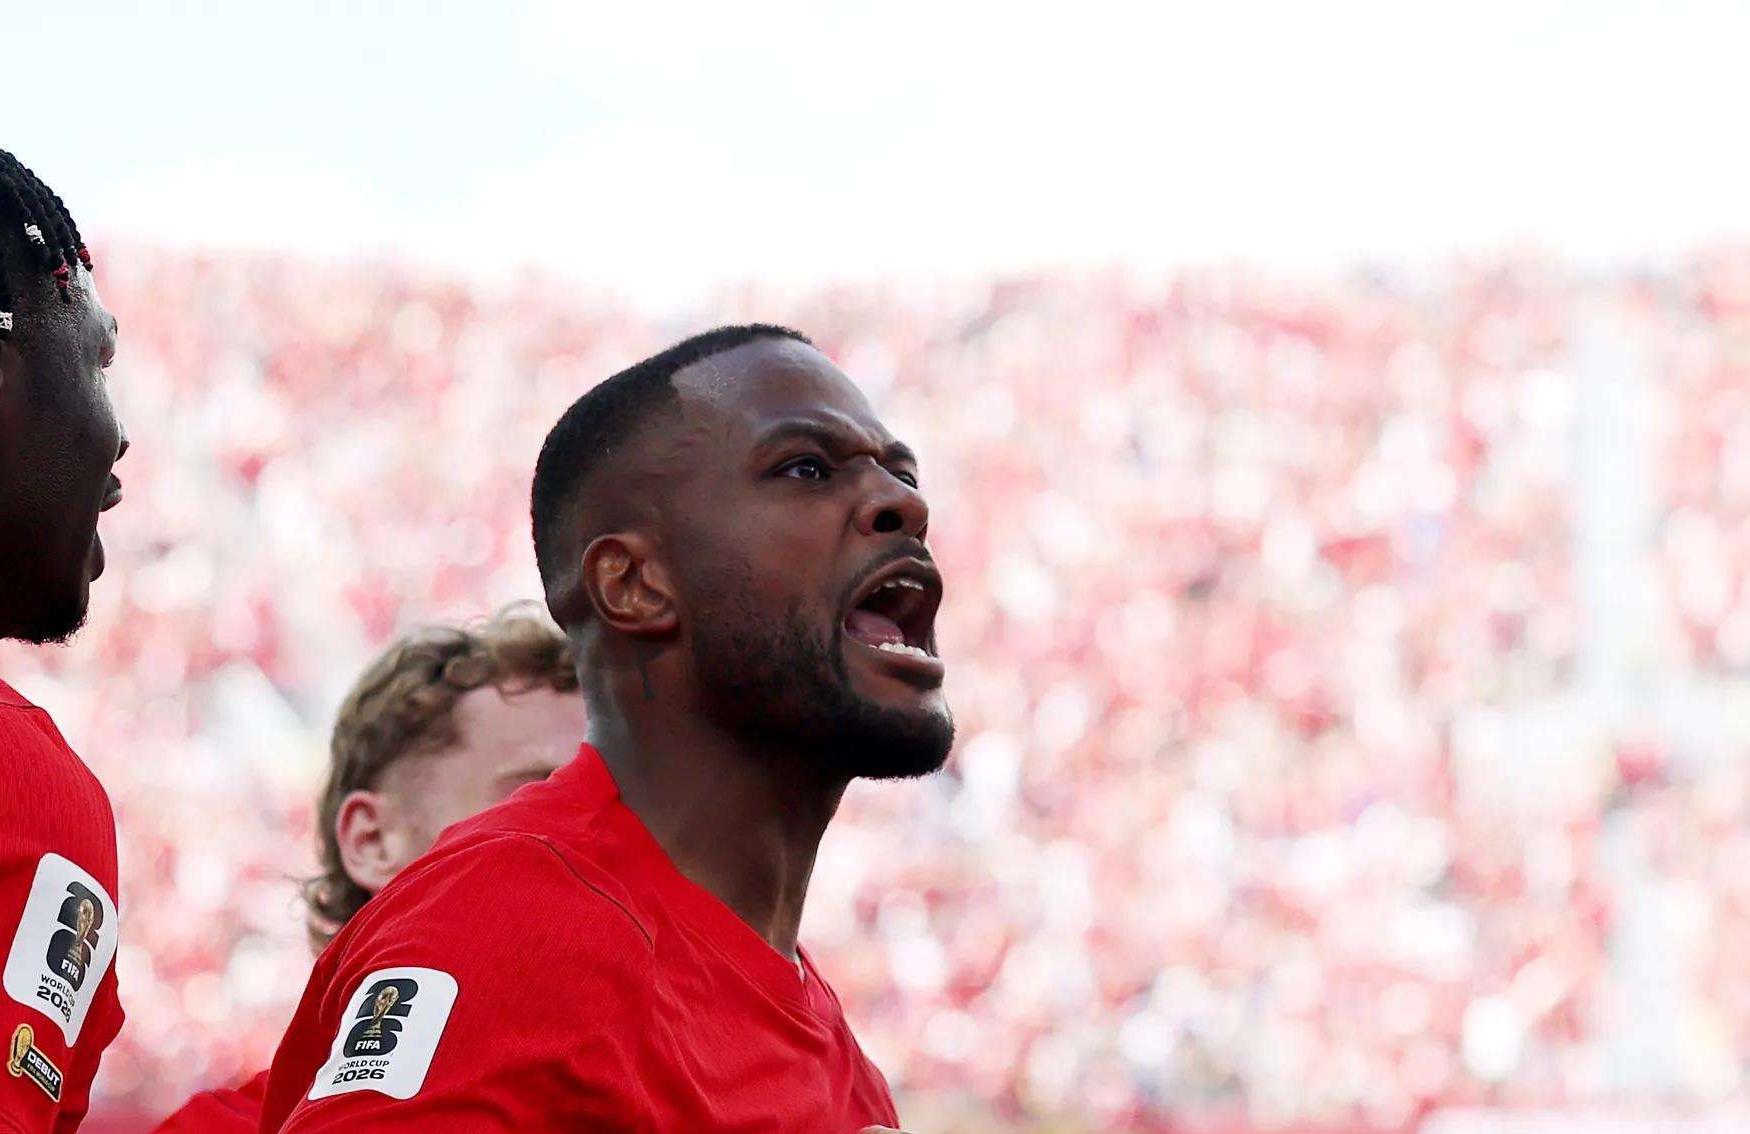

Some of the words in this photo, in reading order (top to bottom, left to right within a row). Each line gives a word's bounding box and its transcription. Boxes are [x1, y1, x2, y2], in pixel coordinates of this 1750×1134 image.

[61, 958, 80, 981] FIFA
[37, 985, 72, 1023] 2026
[355, 1040, 381, 1051] FIFA
[27, 1051, 61, 1086] DEBUT
[369, 1059, 390, 1067] CUP
[332, 1069, 386, 1085] 2026
